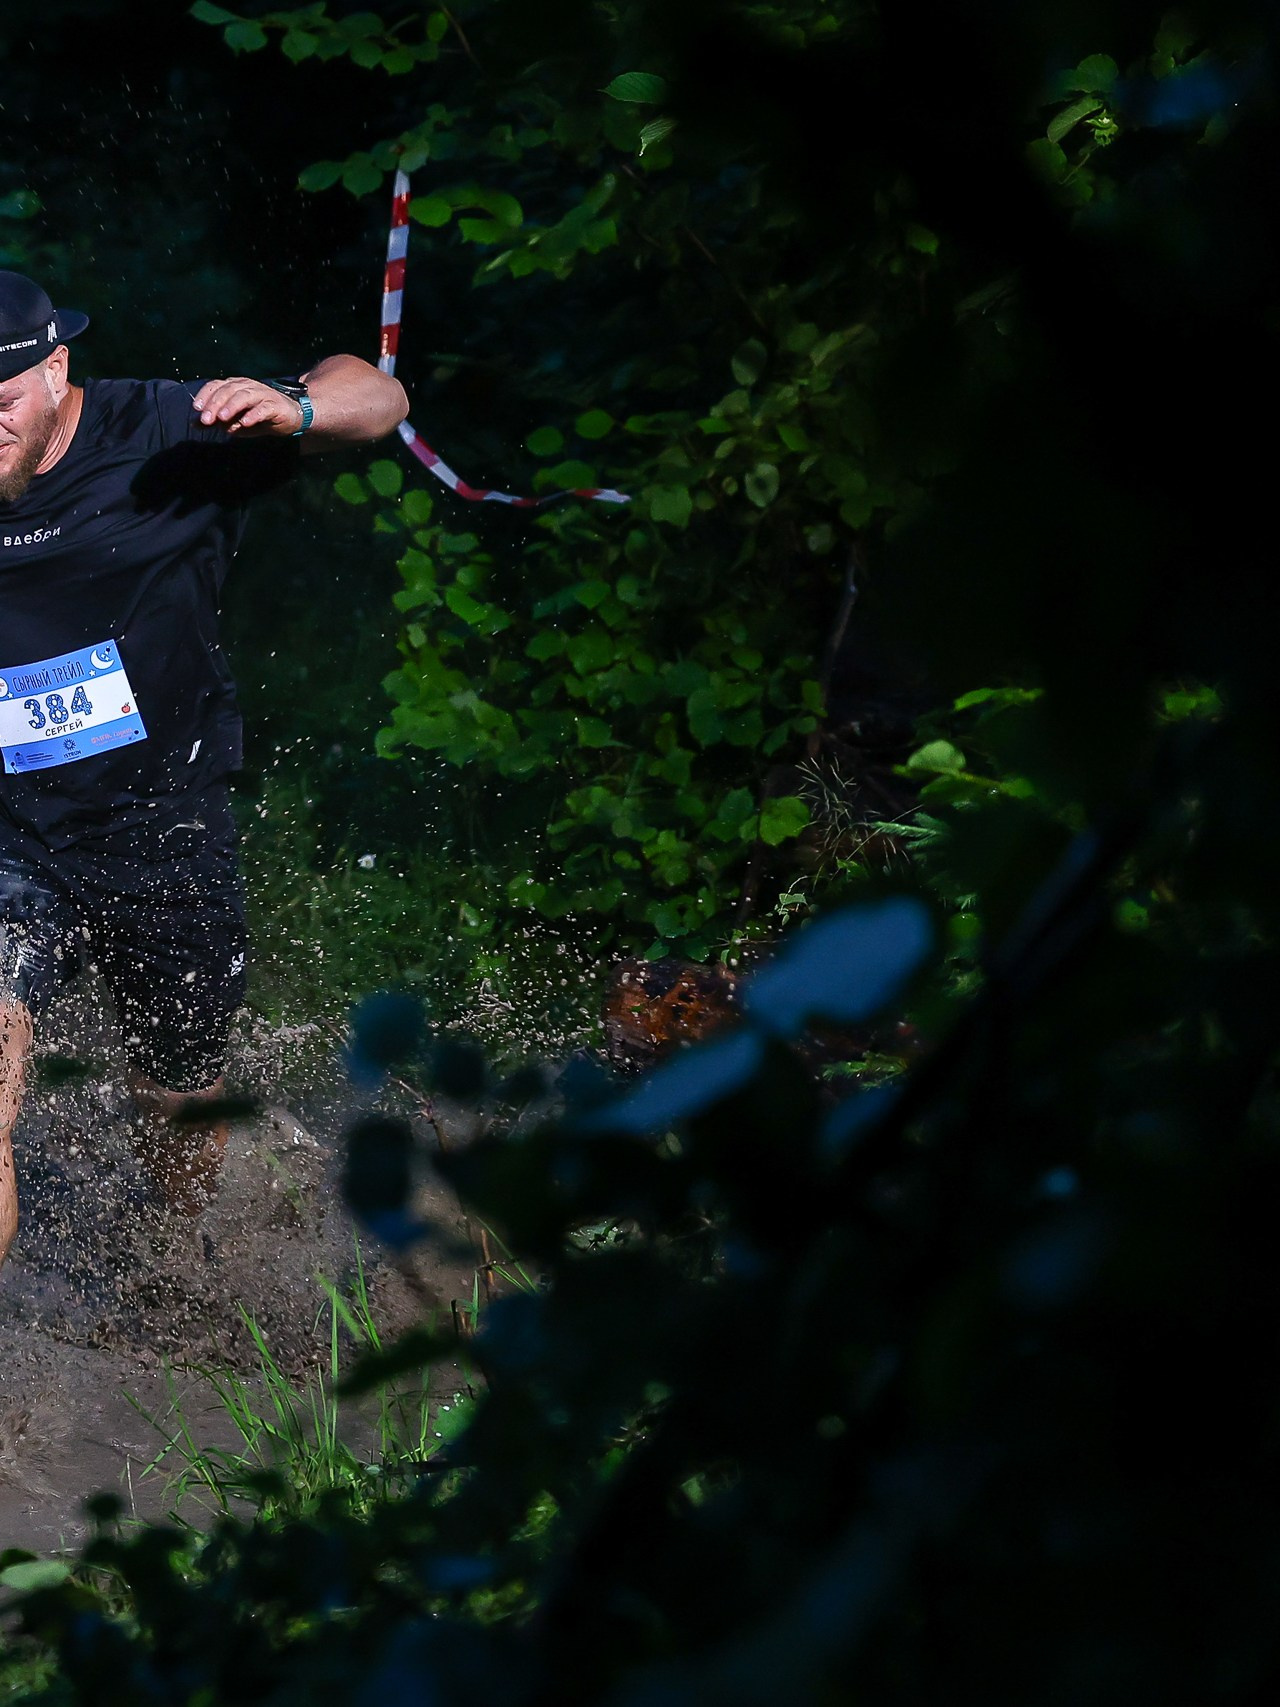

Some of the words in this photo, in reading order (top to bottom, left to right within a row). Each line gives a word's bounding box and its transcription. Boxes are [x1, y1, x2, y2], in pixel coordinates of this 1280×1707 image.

[12, 667, 52, 693] СЫРНЫЙ
[52, 661, 86, 685] ТРЕЙЛ
[23, 685, 93, 730] 384
[45, 718, 84, 738] СЕРГЕЙ
